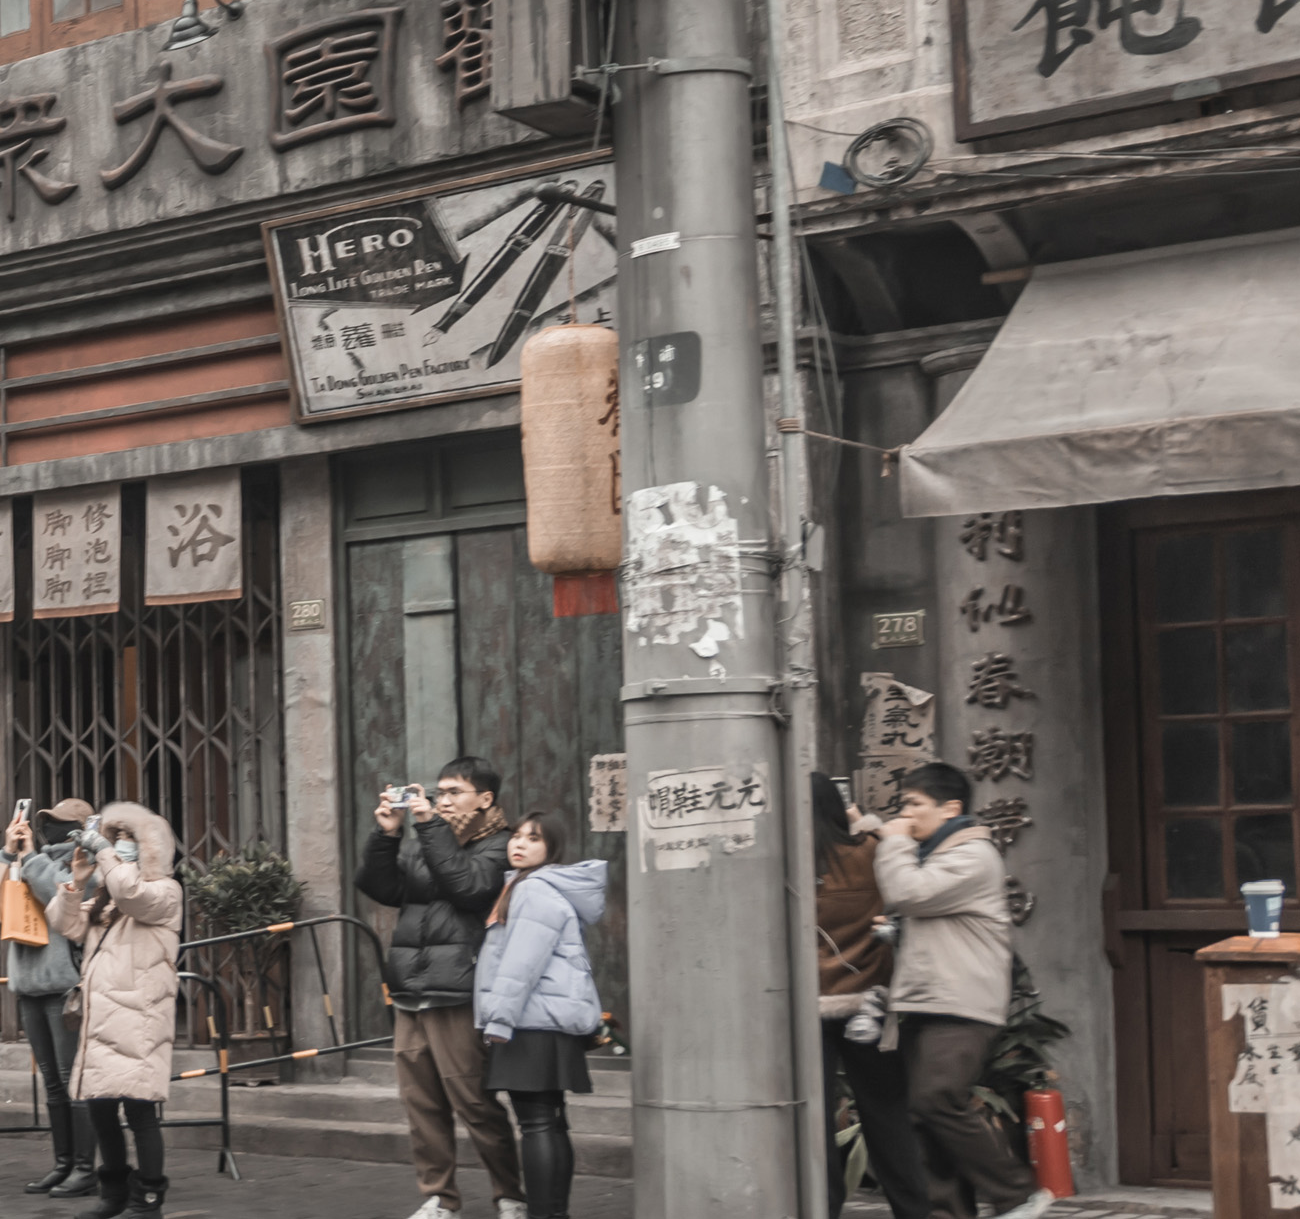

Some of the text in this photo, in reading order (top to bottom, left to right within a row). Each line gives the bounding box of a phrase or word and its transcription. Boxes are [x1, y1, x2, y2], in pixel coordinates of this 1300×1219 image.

[296, 229, 416, 277] HERO
[289, 258, 444, 298] LONG LIFE GOLDEN PEN
[369, 276, 454, 299] TRADE MARK
[167, 502, 236, 570] 浴
[291, 603, 320, 618] 280
[878, 616, 917, 633] 278
